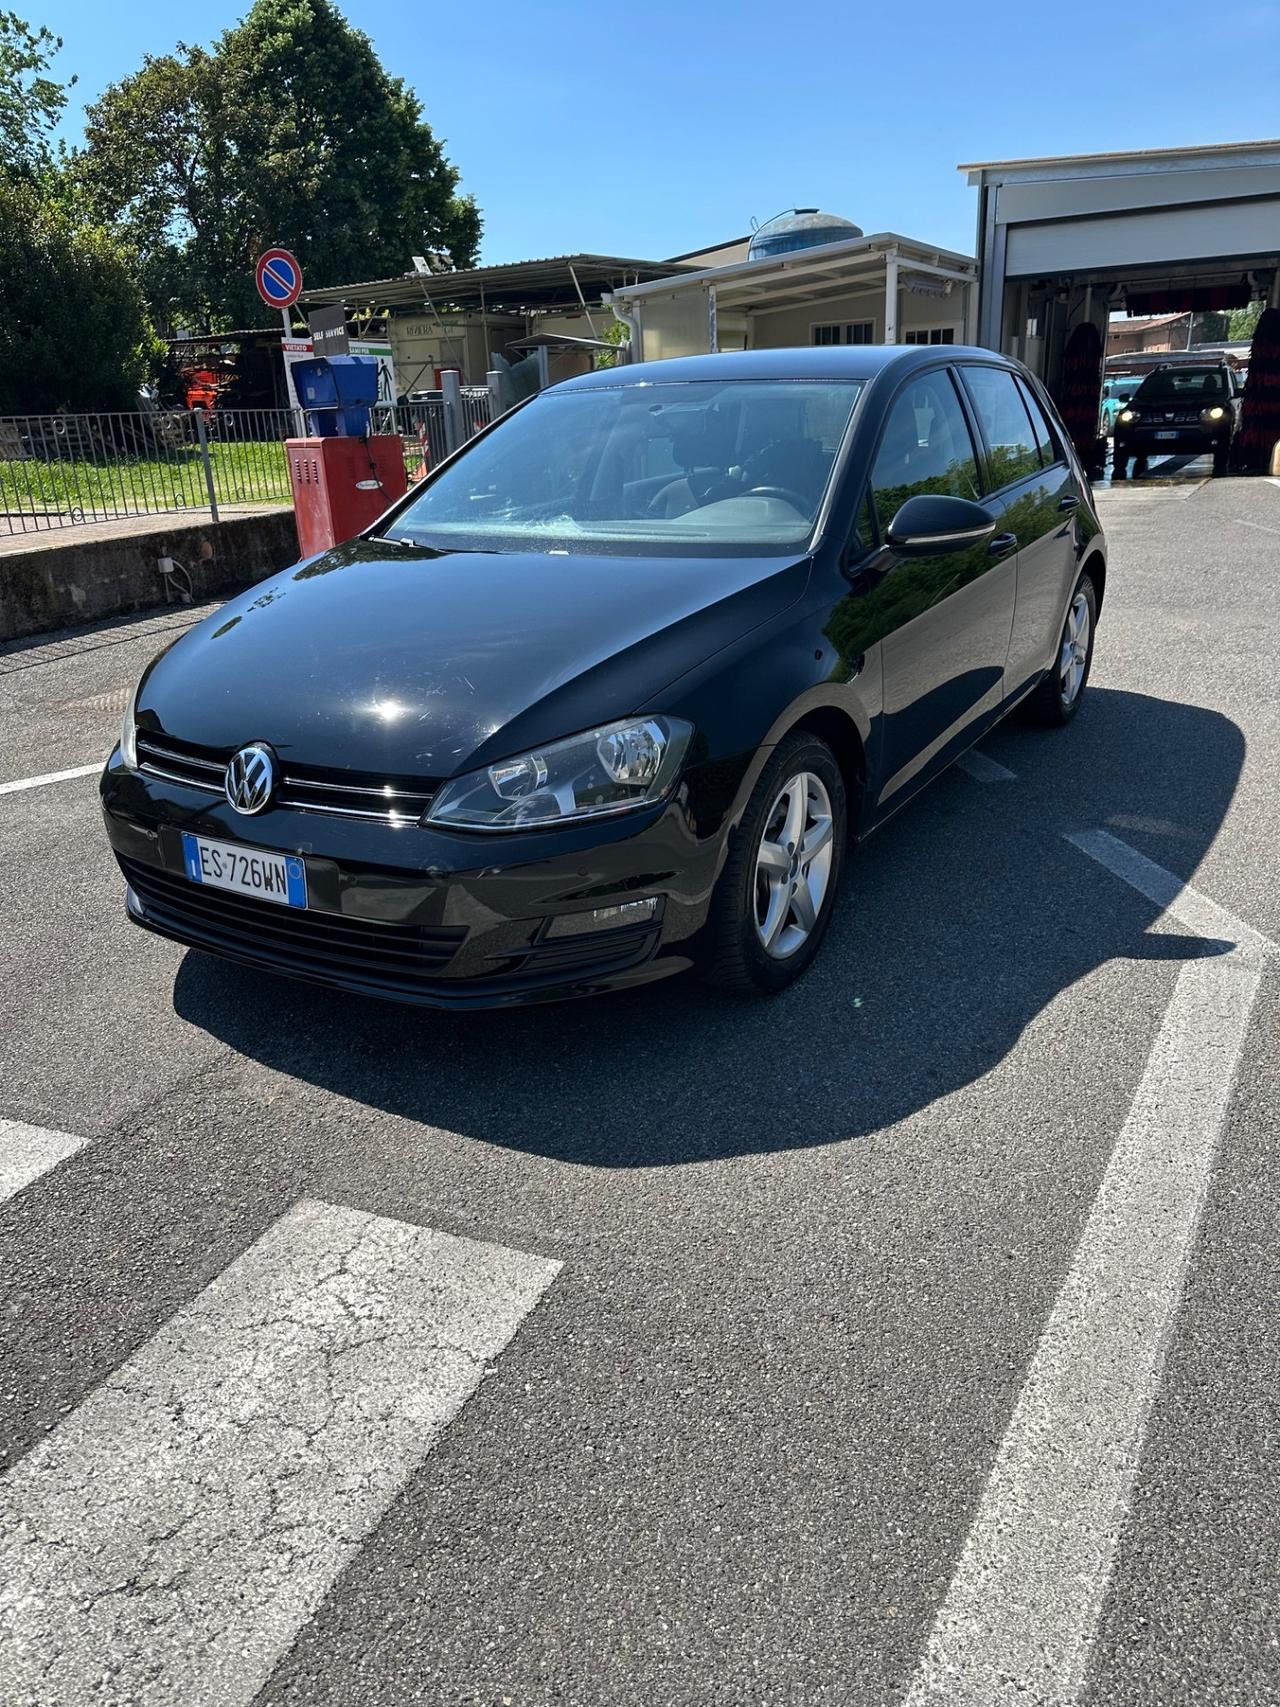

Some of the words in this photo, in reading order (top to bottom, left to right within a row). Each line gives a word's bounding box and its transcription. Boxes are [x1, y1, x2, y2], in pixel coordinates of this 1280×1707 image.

[313, 330, 324, 341] SELF
[325, 325, 345, 338] SERVICE
[285, 344, 308, 352] VIETATO
